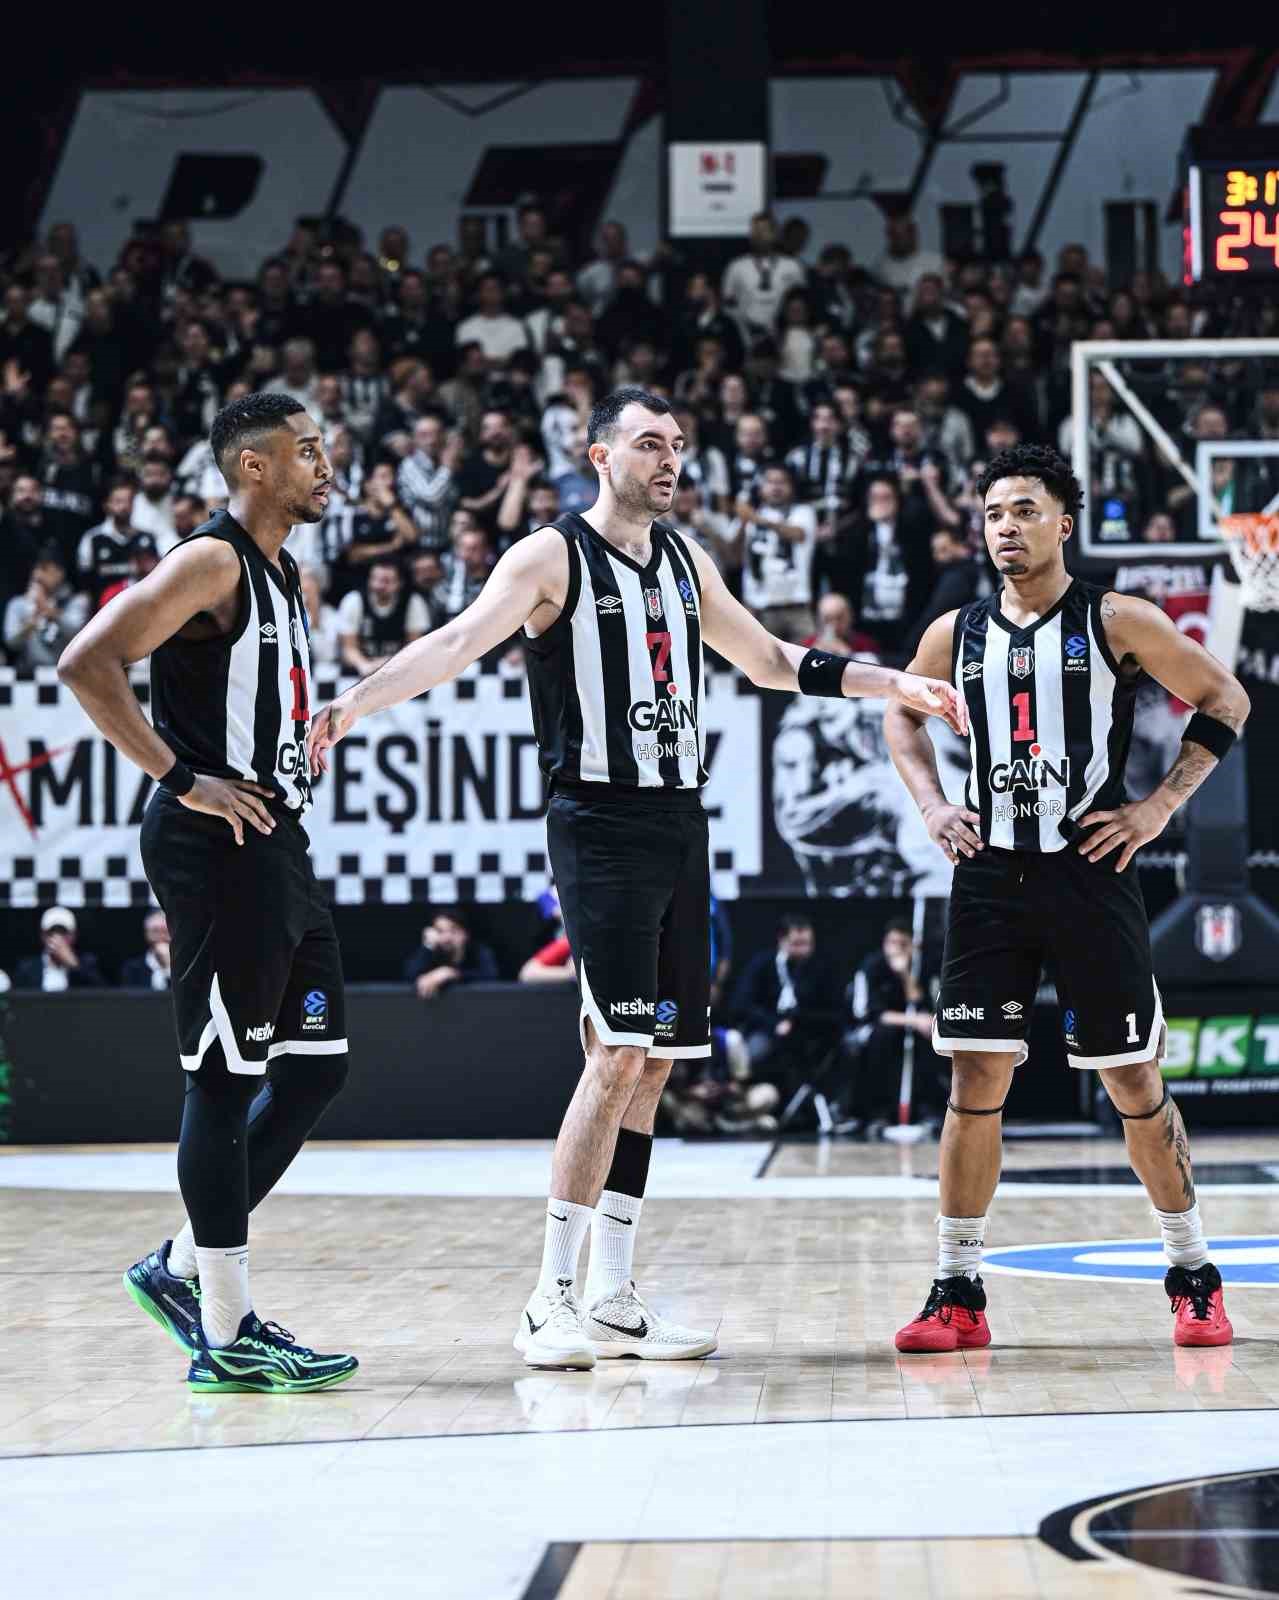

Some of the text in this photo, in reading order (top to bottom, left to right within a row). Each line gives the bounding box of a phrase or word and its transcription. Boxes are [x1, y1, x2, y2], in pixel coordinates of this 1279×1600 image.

[1226, 171, 1279, 206] 3:1
[1216, 211, 1279, 271] 24
[646, 632, 672, 682] 7
[964, 673, 982, 682] umbro
[1012, 692, 1035, 742] 1
[638, 741, 696, 760] HONOR
[994, 799, 1062, 822] HONOR
[306, 1016, 324, 1024] BKT
[1126, 1013, 1140, 1043] 1
[1159, 1025, 1279, 1068] BKT
